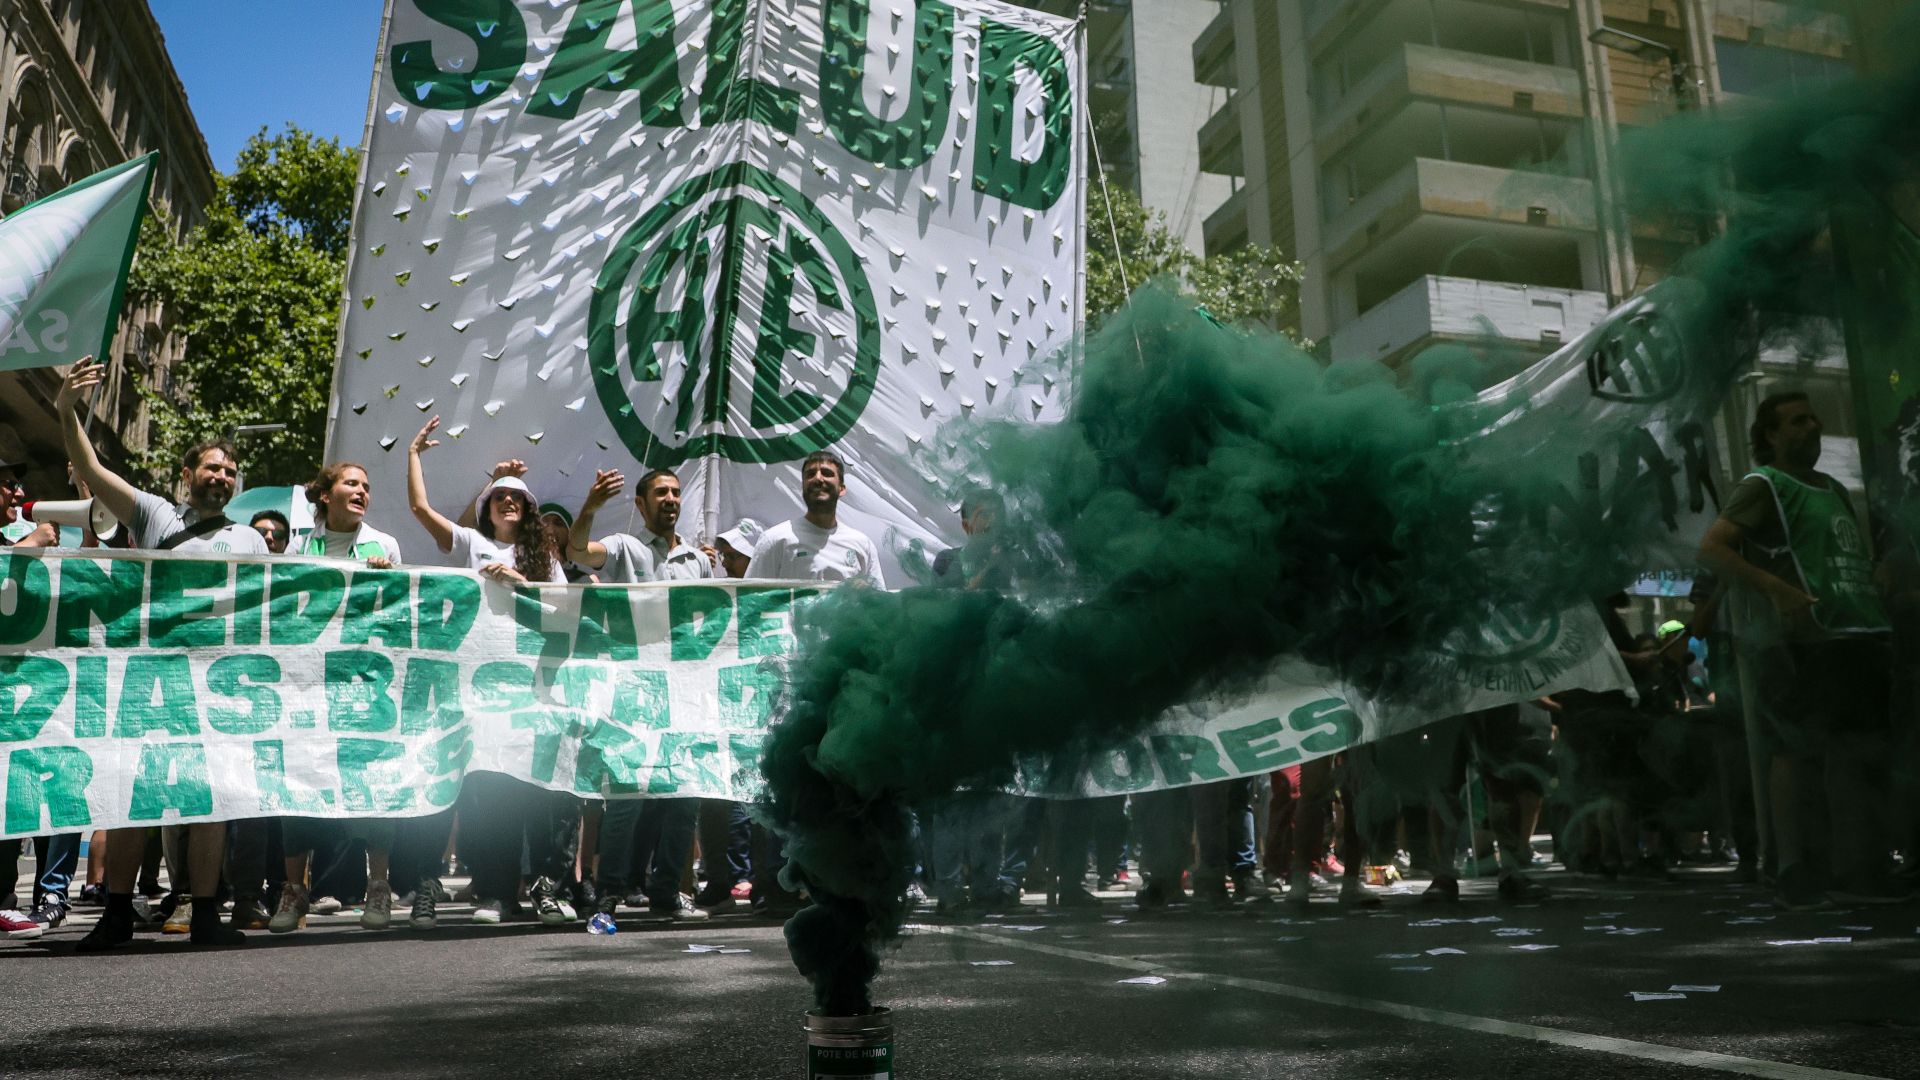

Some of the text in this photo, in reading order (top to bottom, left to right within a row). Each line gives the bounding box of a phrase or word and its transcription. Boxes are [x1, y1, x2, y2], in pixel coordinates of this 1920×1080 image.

[391, 0, 1072, 211] SALUD
[0, 553, 482, 652] ONEIDAD
[515, 587, 640, 661] LA
[817, 1047, 887, 1059] POTE DE HUMO
